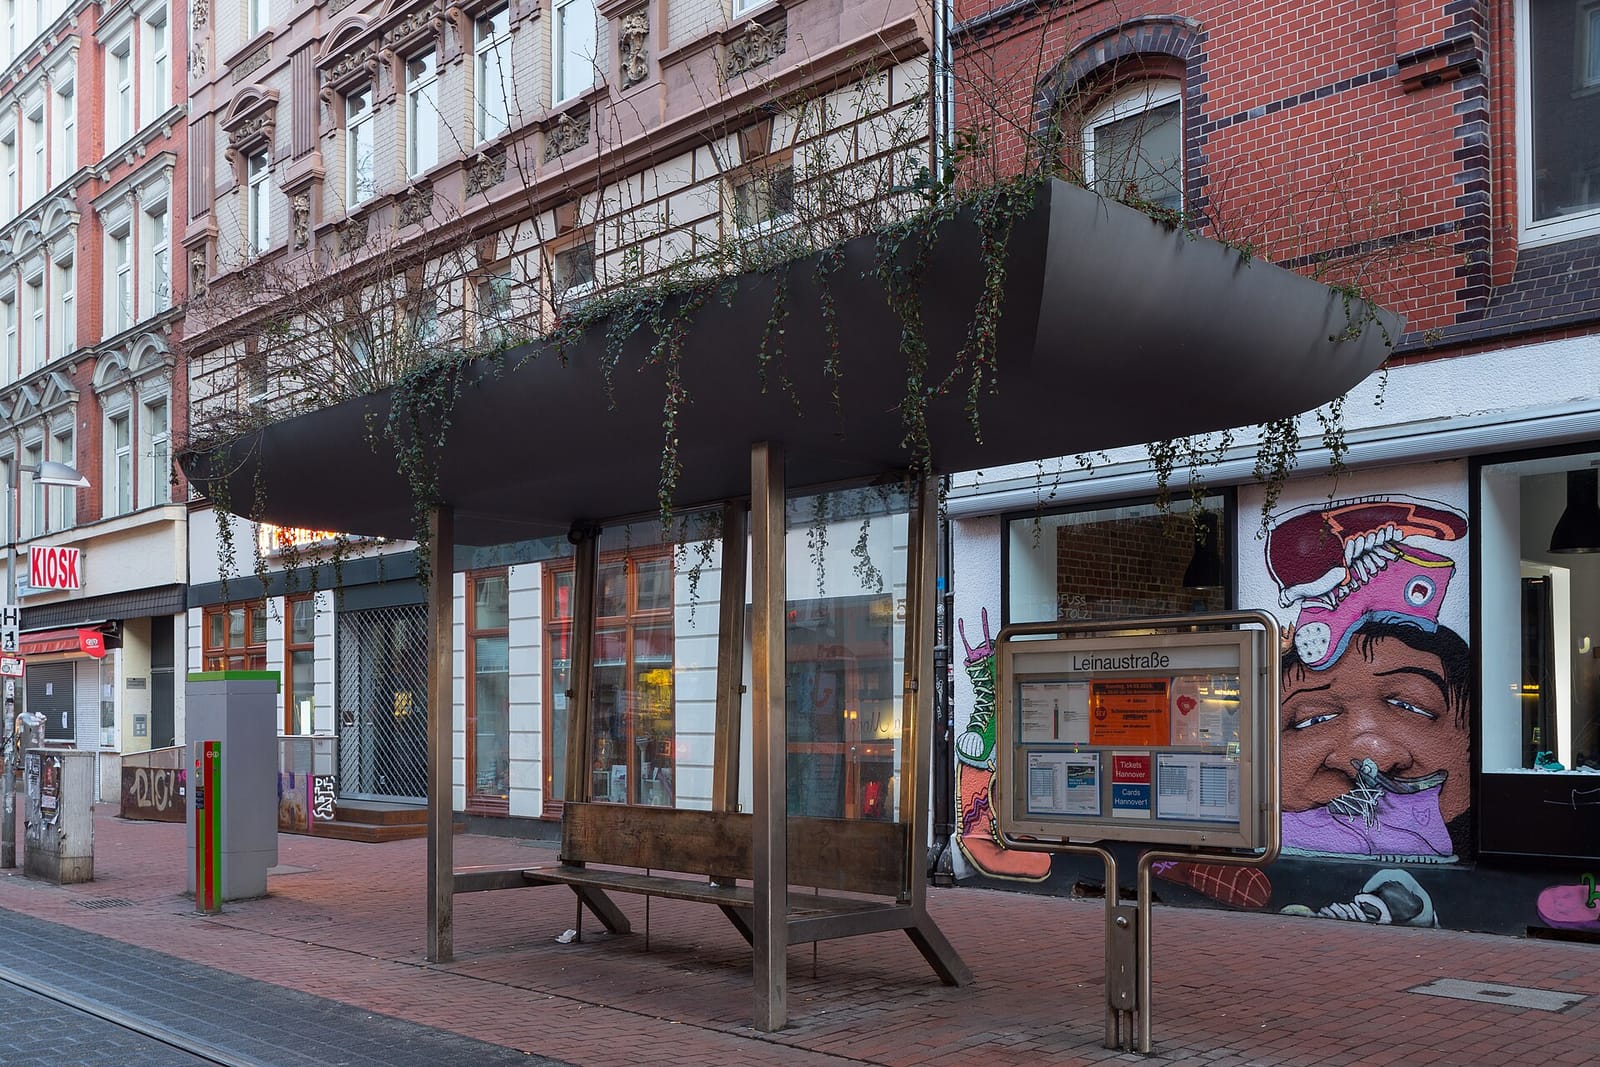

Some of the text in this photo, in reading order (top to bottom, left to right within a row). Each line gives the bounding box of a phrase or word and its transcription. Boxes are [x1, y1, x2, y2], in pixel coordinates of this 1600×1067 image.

[31, 546, 79, 588] KIOSK
[1073, 652, 1170, 671] Leinaustraße
[1120, 761, 1142, 769] Tickets
[1121, 788, 1141, 796] Cards
